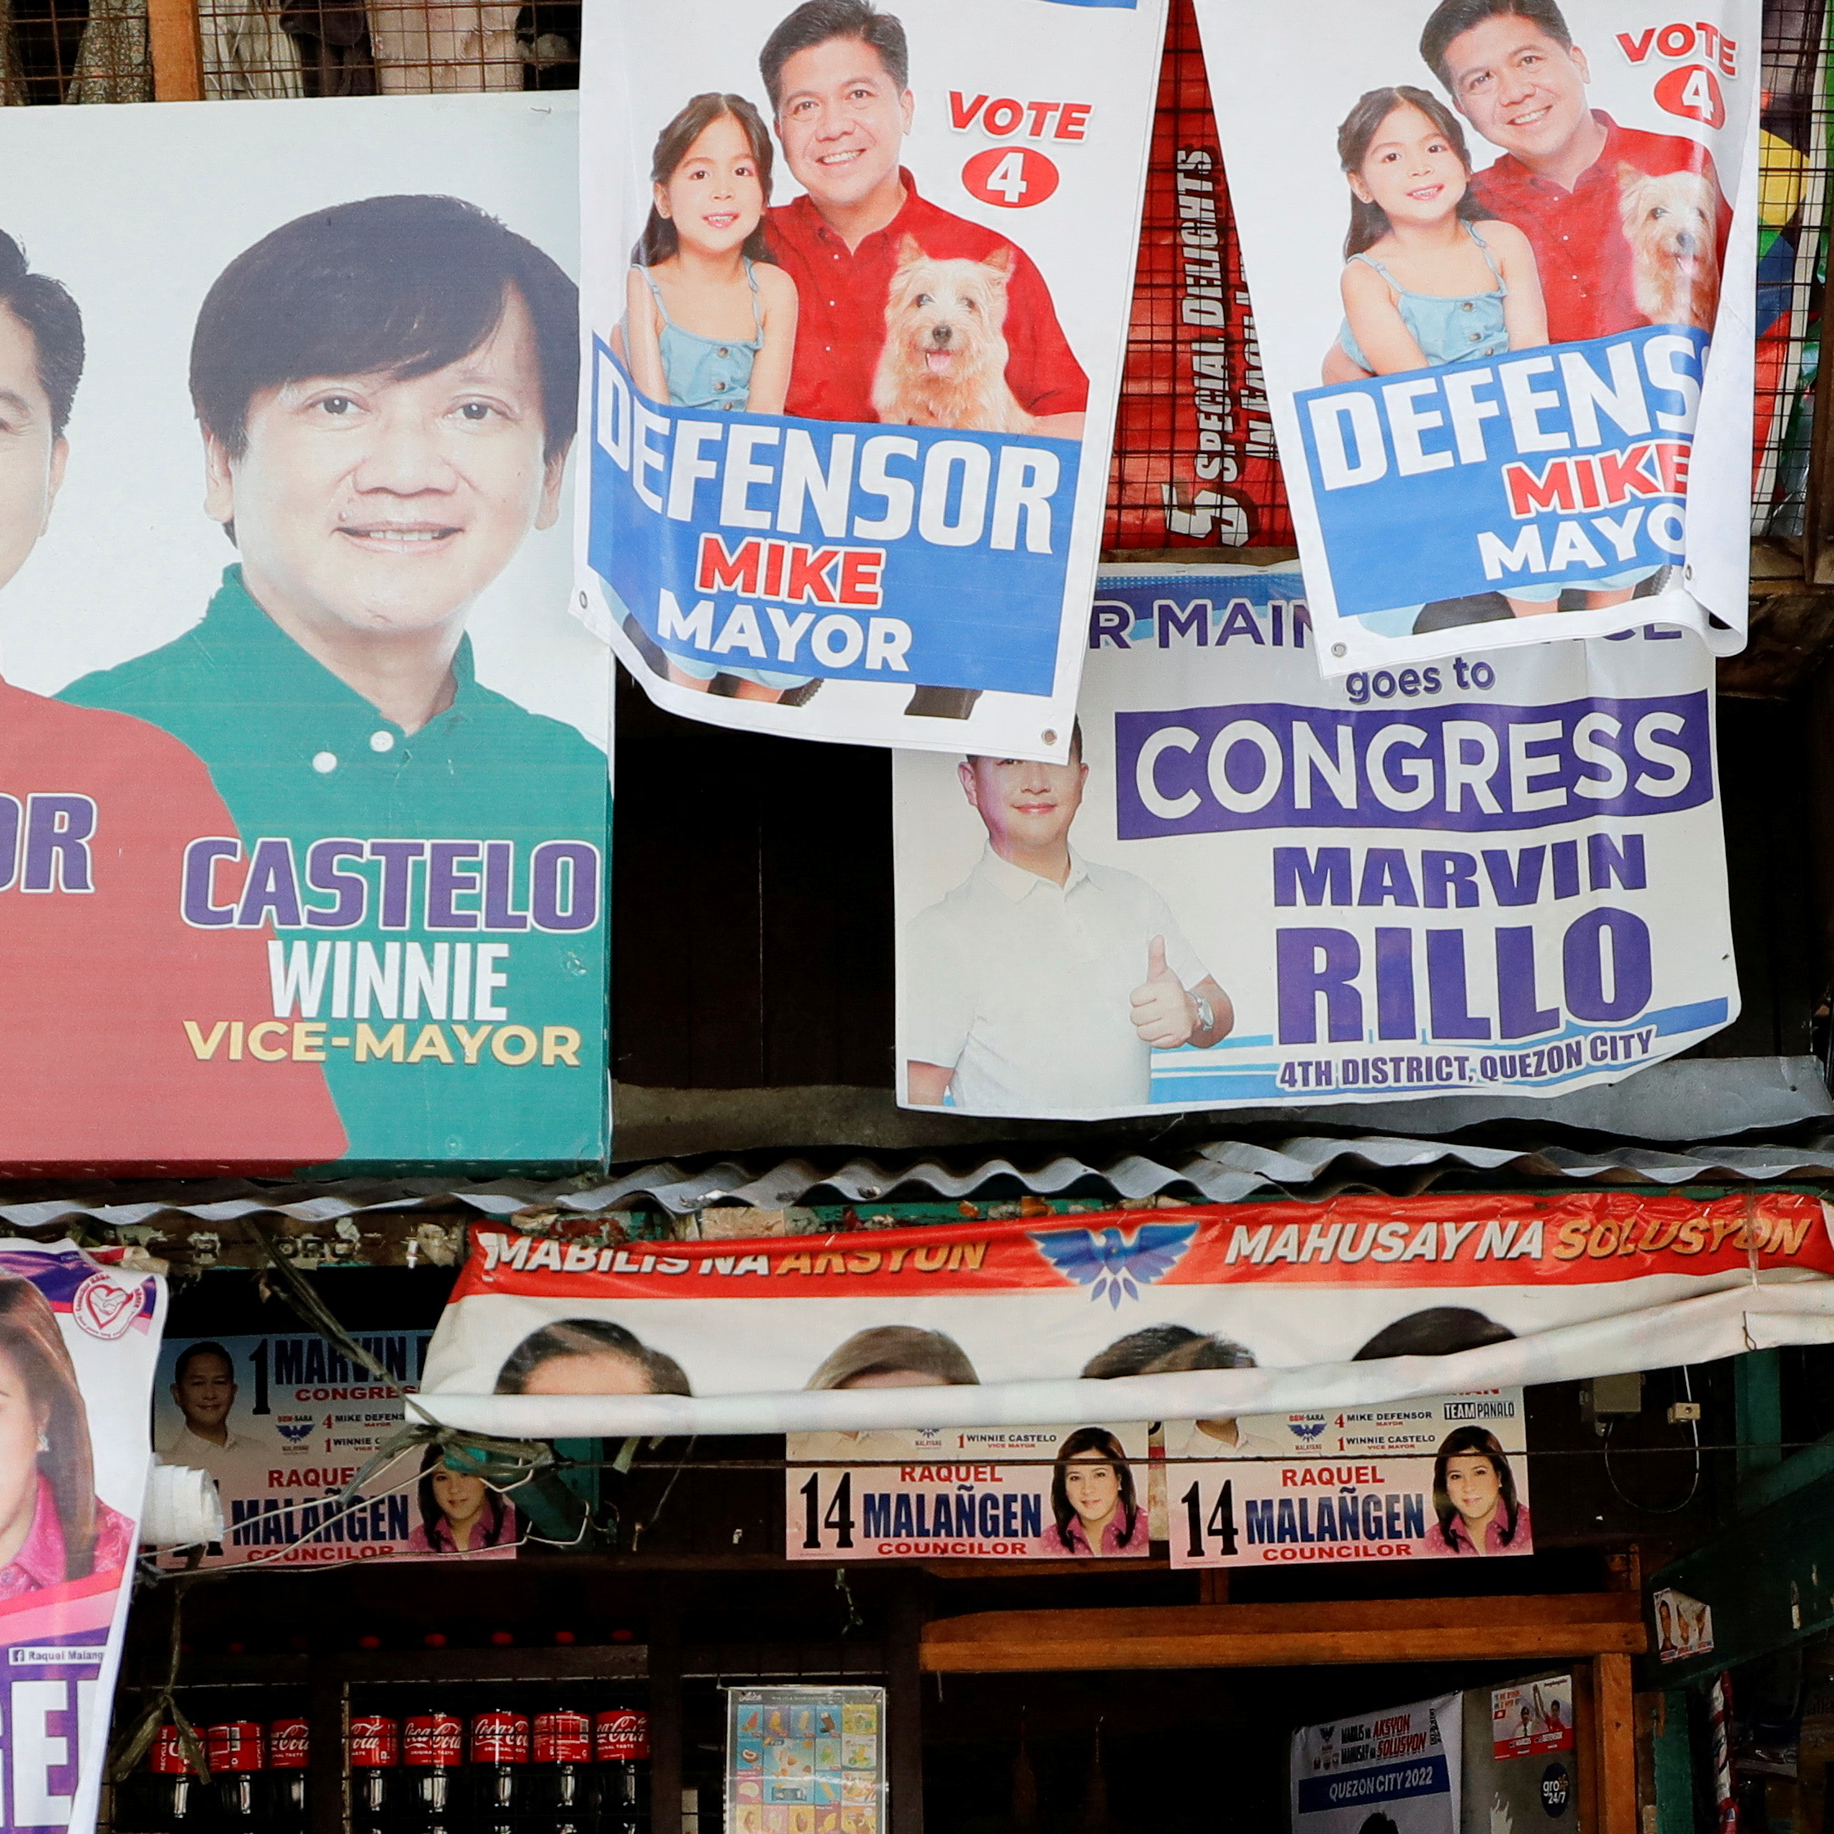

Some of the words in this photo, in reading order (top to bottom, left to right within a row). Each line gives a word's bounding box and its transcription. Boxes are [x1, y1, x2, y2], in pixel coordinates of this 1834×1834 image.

[1616, 22, 1738, 76] VOTE
[947, 90, 1092, 144] VOTE
[596, 344, 1060, 555] DEFENSOR
[695, 533, 885, 610] MIKE
[656, 590, 913, 673] MAYOR
[1346, 662, 1442, 705] goes
[1454, 657, 1496, 690] to
[1134, 710, 1693, 820] CONGRESS
[180, 837, 601, 933] CASTELO
[1273, 833, 1648, 909] MARVIN
[267, 940, 510, 1020] WINNIE
[1274, 907, 1654, 1047] RILLO
[183, 1020, 581, 1068] VICE-MAYOR
[1278, 1059, 1337, 1090] 4TH
[1341, 1055, 1476, 1087] DISTRICT,
[1477, 1042, 1585, 1082] QUEZON
[1588, 1028, 1655, 1068] CITY
[1225, 1220, 1480, 1266] MAHUSAY
[1481, 1220, 1545, 1261] NA
[1552, 1218, 1814, 1258] SOLUSYON
[1347, 1413, 1374, 1421] MIKE
[1376, 1411, 1433, 1421] DEFENSOR
[1445, 1403, 1475, 1419] TEAM
[1477, 1402, 1515, 1417] PANALO
[1346, 1436, 1386, 1445] WINNIE
[1388, 1435, 1436, 1443] CASTELO
[900, 1465, 1003, 1483] RAQUEL
[1282, 1466, 1385, 1487] RAQUEL
[799, 1472, 855, 1549] 14
[864, 1484, 1041, 1538] MALAÑGEN
[1181, 1479, 1239, 1556] 14
[1245, 1487, 1425, 1544] MALAÑGEN
[877, 1541, 1027, 1555] COUNCILOR
[1263, 1544, 1412, 1561] COUNCILOR
[1373, 1714, 1411, 1738] AKSYON
[1376, 1732, 1427, 1758] SOLUSYON
[1329, 1777, 1375, 1802] QUEZON
[1376, 1772, 1404, 1792] CITY
[1405, 1766, 1434, 1787] 2022
